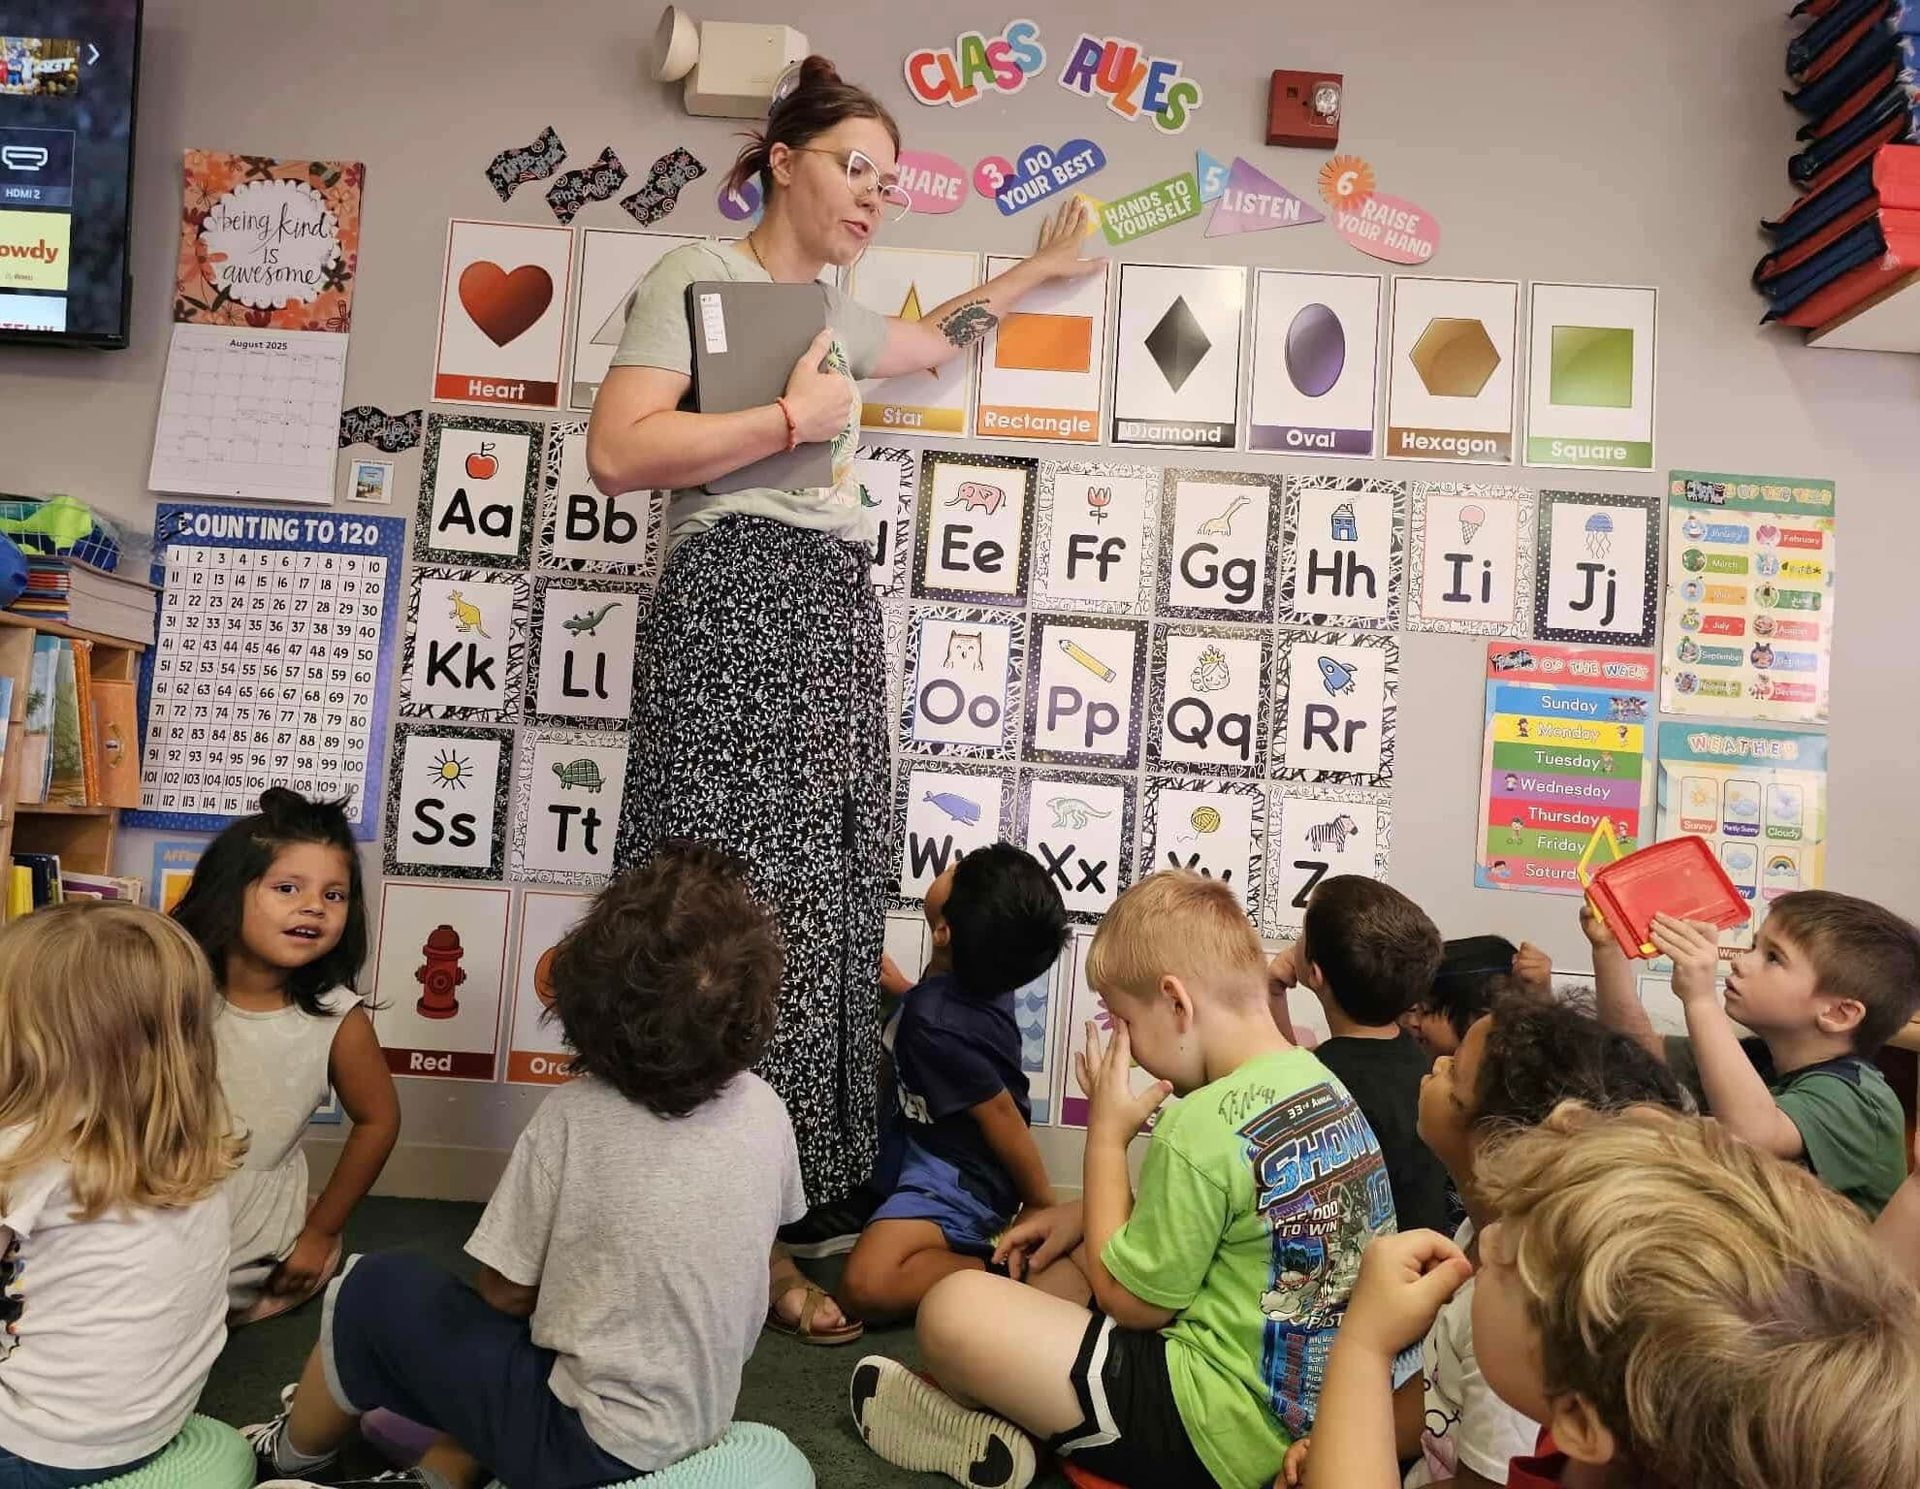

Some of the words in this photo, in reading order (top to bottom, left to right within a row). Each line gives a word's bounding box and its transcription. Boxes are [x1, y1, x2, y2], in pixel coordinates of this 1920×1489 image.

[906, 21, 1045, 104] CLASS
[1060, 35, 1200, 132] RULES
[1024, 150, 1053, 176] DO
[898, 165, 962, 200] HARE
[982, 164, 1003, 189] 3
[1000, 177, 1051, 211] YOUR
[1055, 149, 1097, 185] BEST
[1205, 166, 1223, 192] 5
[1336, 171, 1359, 196] 6
[5, 188, 32, 199] HDMI
[33, 190, 41, 199] 2
[1104, 191, 1161, 225] HANDS
[1165, 180, 1188, 199] TO
[1222, 188, 1301, 220] LISTEN
[216, 205, 271, 241] being
[277, 202, 328, 242] kind
[1111, 195, 1192, 238] YOURSELF
[1360, 199, 1420, 233] RAISE
[1338, 212, 1382, 241] YOUR
[1384, 230, 1432, 257] HAND
[0, 239, 58, 264] owdy
[263, 249, 279, 264] is
[223, 265, 321, 285] awesome
[230, 339, 263, 350] August
[265, 341, 288, 350] 2025
[468, 380, 526, 400] Heart
[883, 407, 922, 426] Star
[984, 412, 1091, 436] Rectangle
[1129, 422, 1221, 442] Diamond
[1286, 429, 1336, 449] Oval
[1401, 431, 1497, 456] Hexagon
[1551, 441, 1627, 465] Square
[438, 487, 513, 538] Aa
[566, 494, 637, 544] Bb
[178, 512, 299, 541] COUNTING
[304, 519, 334, 543] TO
[339, 523, 378, 545] 120
[940, 523, 1004, 574] Ee
[1066, 533, 1127, 582] Ff
[197, 551, 204, 563] 2
[218, 553, 225, 564] 3
[239, 554, 246, 565] 4
[260, 555, 268, 566] 5
[282, 556, 289, 567] 6
[304, 557, 311, 568] 7
[324, 558, 332, 569] 8
[348, 560, 356, 571] 9
[369, 561, 380, 573] 10
[1180, 542, 1256, 604] Gg
[1306, 548, 1377, 599] Hh
[172, 571, 179, 582] 11
[193, 572, 202, 584] 12
[214, 573, 224, 585] 13
[235, 575, 246, 586] 14
[257, 576, 267, 587] 15
[278, 577, 288, 588] 16
[299, 578, 310, 589] 17
[320, 579, 332, 590] 18
[344, 581, 355, 592] 19
[365, 582, 380, 594] 20
[1442, 552, 1492, 604] Ii
[168, 594, 178, 605] 21
[188, 595, 201, 606] 22
[210, 596, 223, 607] 23
[231, 597, 244, 608] 24
[252, 598, 264, 609] 25
[273, 599, 286, 610] 26
[294, 600, 308, 611] 27
[316, 601, 330, 612] 28
[339, 603, 353, 614] 29
[362, 604, 378, 616] 30
[1568, 562, 1616, 627] Jj
[166, 616, 176, 627] 31
[186, 616, 199, 628] 32
[207, 617, 220, 629] 33
[228, 619, 241, 630] 34
[248, 620, 262, 631] 35
[270, 620, 283, 632] 36
[291, 621, 305, 633] 37
[313, 623, 328, 634] 38
[337, 625, 351, 636] 39
[359, 626, 376, 638] 40
[162, 638, 173, 650] 41
[182, 639, 196, 650] 42
[202, 640, 217, 651] 43
[223, 641, 238, 652] 44
[245, 642, 259, 653] 45
[266, 644, 280, 654] 46
[288, 644, 302, 656] 47
[309, 646, 325, 657] 48
[333, 647, 349, 659] 49
[357, 649, 373, 661] 50
[160, 660, 171, 671] 51
[179, 661, 192, 672] 52
[200, 662, 214, 673] 53
[220, 663, 235, 674] 54
[242, 664, 256, 675] 55
[262, 665, 278, 676] 56
[284, 666, 300, 677] 57
[307, 668, 323, 679] 58
[331, 669, 346, 681] 59
[354, 672, 371, 683] 60
[426, 640, 497, 691] Kk
[562, 649, 609, 701] Ll
[918, 677, 1001, 729] Oo
[1541, 696, 1598, 714] Sunday
[1046, 685, 1120, 748] Pp
[1303, 702, 1368, 754] Rr
[1166, 697, 1252, 762] Qq
[1537, 722, 1600, 742] Monday
[1535, 750, 1601, 771] Tuesday
[1520, 777, 1611, 800] Wednesday
[412, 798, 477, 848] Ss
[1528, 806, 1599, 828] Thursday
[1684, 820, 1713, 831] Sunny
[1741, 825, 1758, 834] Sunny
[547, 804, 602, 856] Tt
[1767, 827, 1799, 839] Cloudy
[909, 832, 963, 879] W
[1537, 836, 1586, 855] Friday
[1038, 841, 1108, 894] Xx
[1526, 863, 1595, 882] Saturd
[1291, 860, 1329, 908] Z
[410, 1053, 452, 1072] Red
[1288, 1101, 1309, 1119] 33rd
[1275, 1200, 1338, 1229] ,000
[1281, 1223, 1301, 1237] TO
[1309, 1220, 1337, 1236] WIN
[1306, 1312, 1344, 1329] PAST
